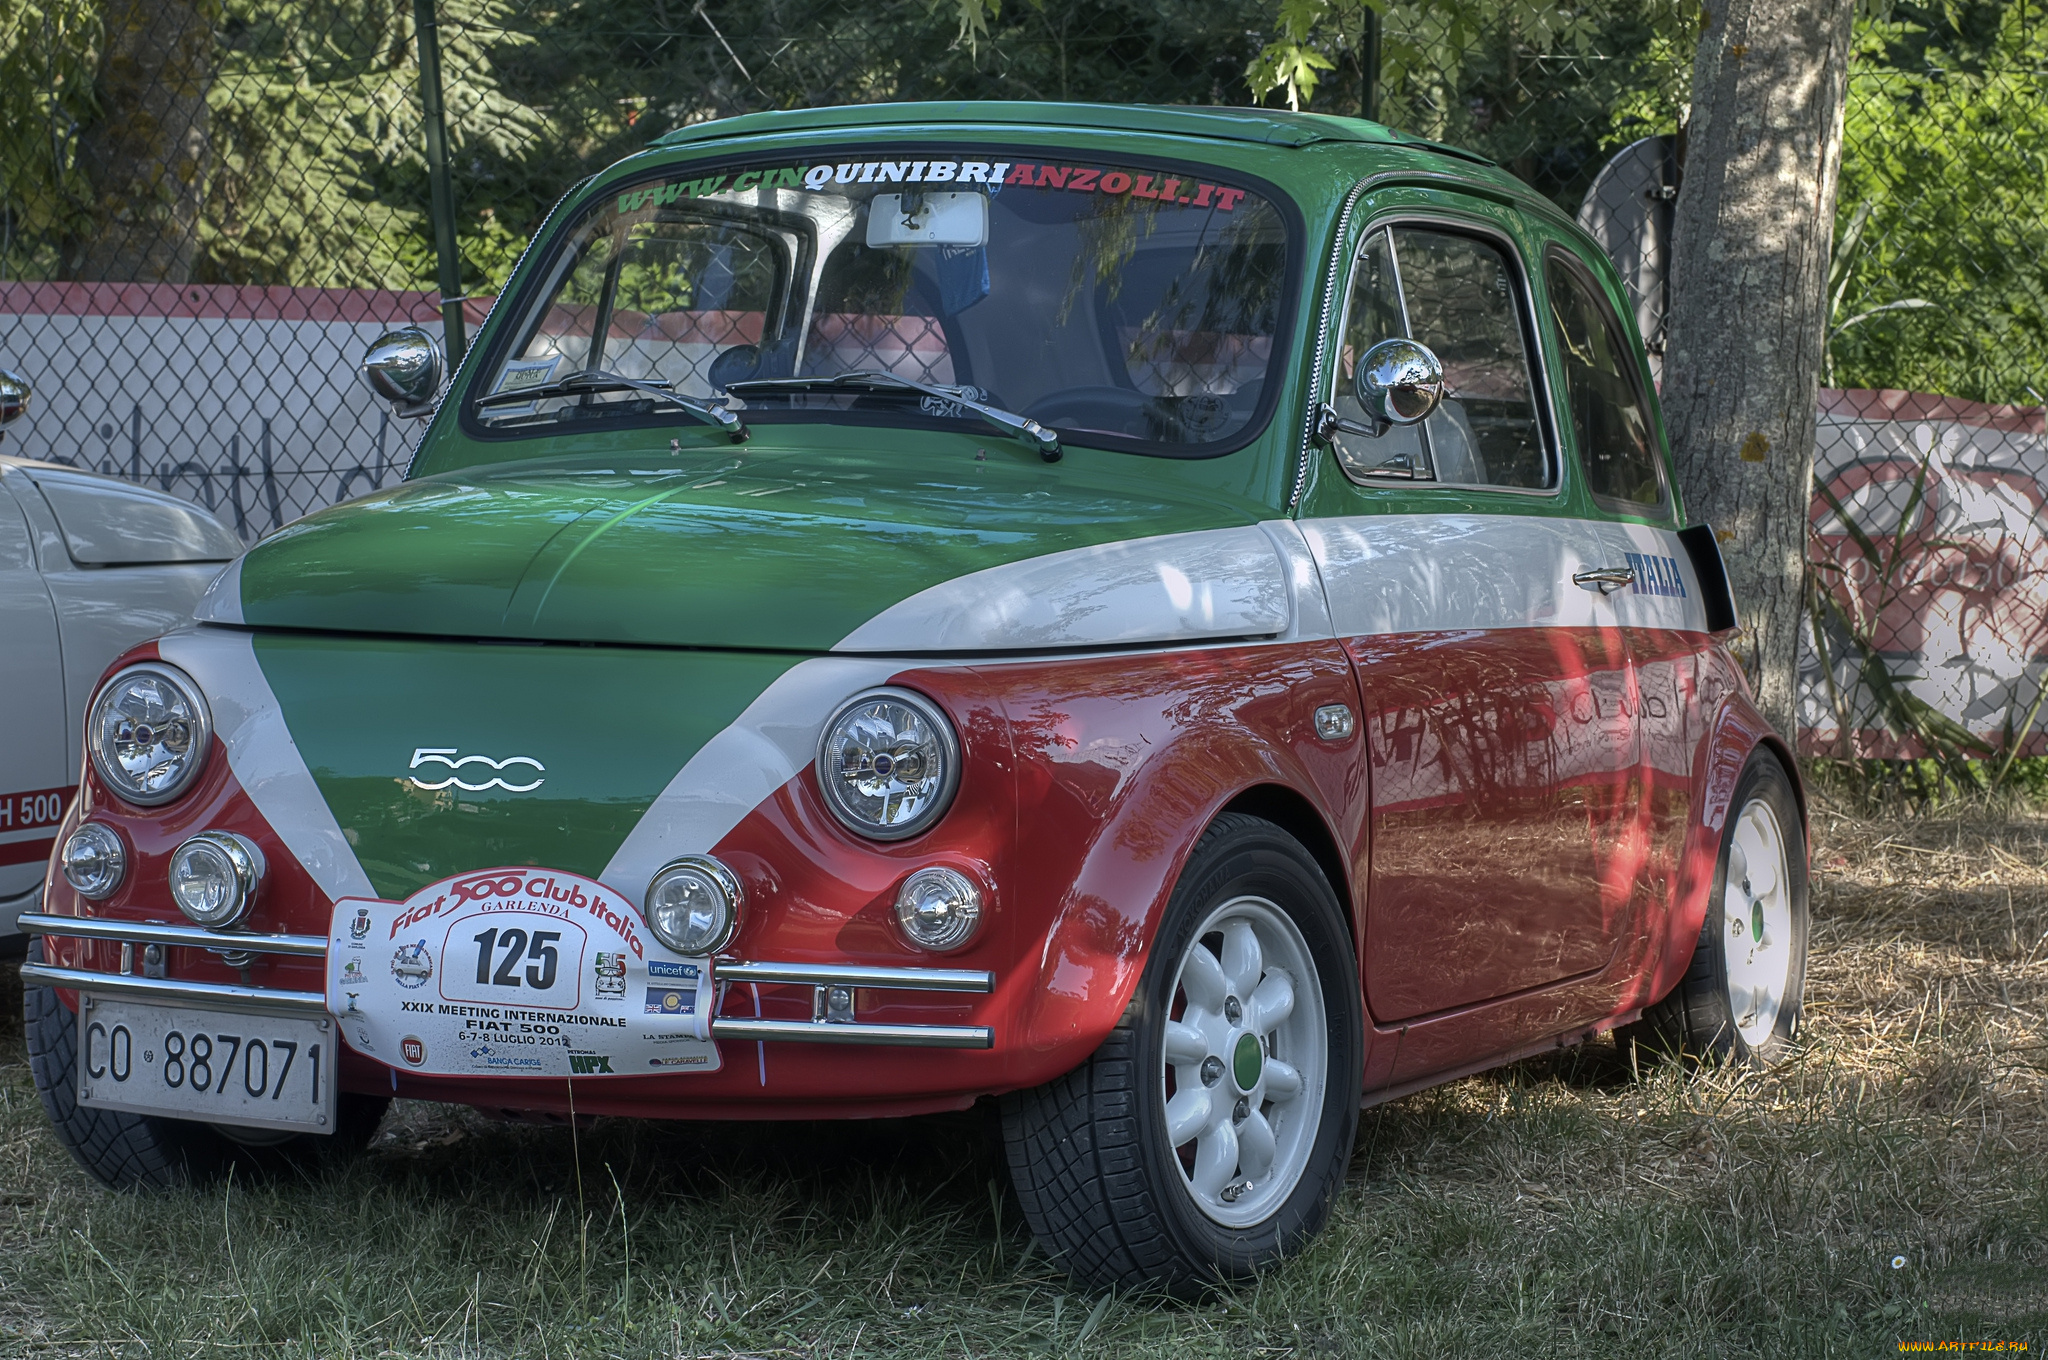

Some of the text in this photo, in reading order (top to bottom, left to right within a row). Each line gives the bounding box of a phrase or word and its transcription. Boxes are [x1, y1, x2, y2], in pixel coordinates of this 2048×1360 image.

[1624, 552, 1686, 598] ITALIA
[408, 748, 546, 792] 500
[20, 793, 61, 825] 500
[389, 870, 643, 961] Fiat 500 Club Italia
[481, 900, 570, 918] GARLENDA
[1177, 866, 1231, 938] YOKOHAMA
[473, 927, 561, 990] 125
[650, 965, 683, 976] unicef
[401, 1001, 627, 1027] XXIX MEETING INTERNAZIONALE
[465, 1019, 560, 1035] FIAT 500
[405, 1043, 421, 1059] FIAT
[459, 1031, 569, 1047] 6-7-8 LUGLIO 2012
[86, 1021, 321, 1104] CO 887071
[569, 1055, 614, 1074] HPX
